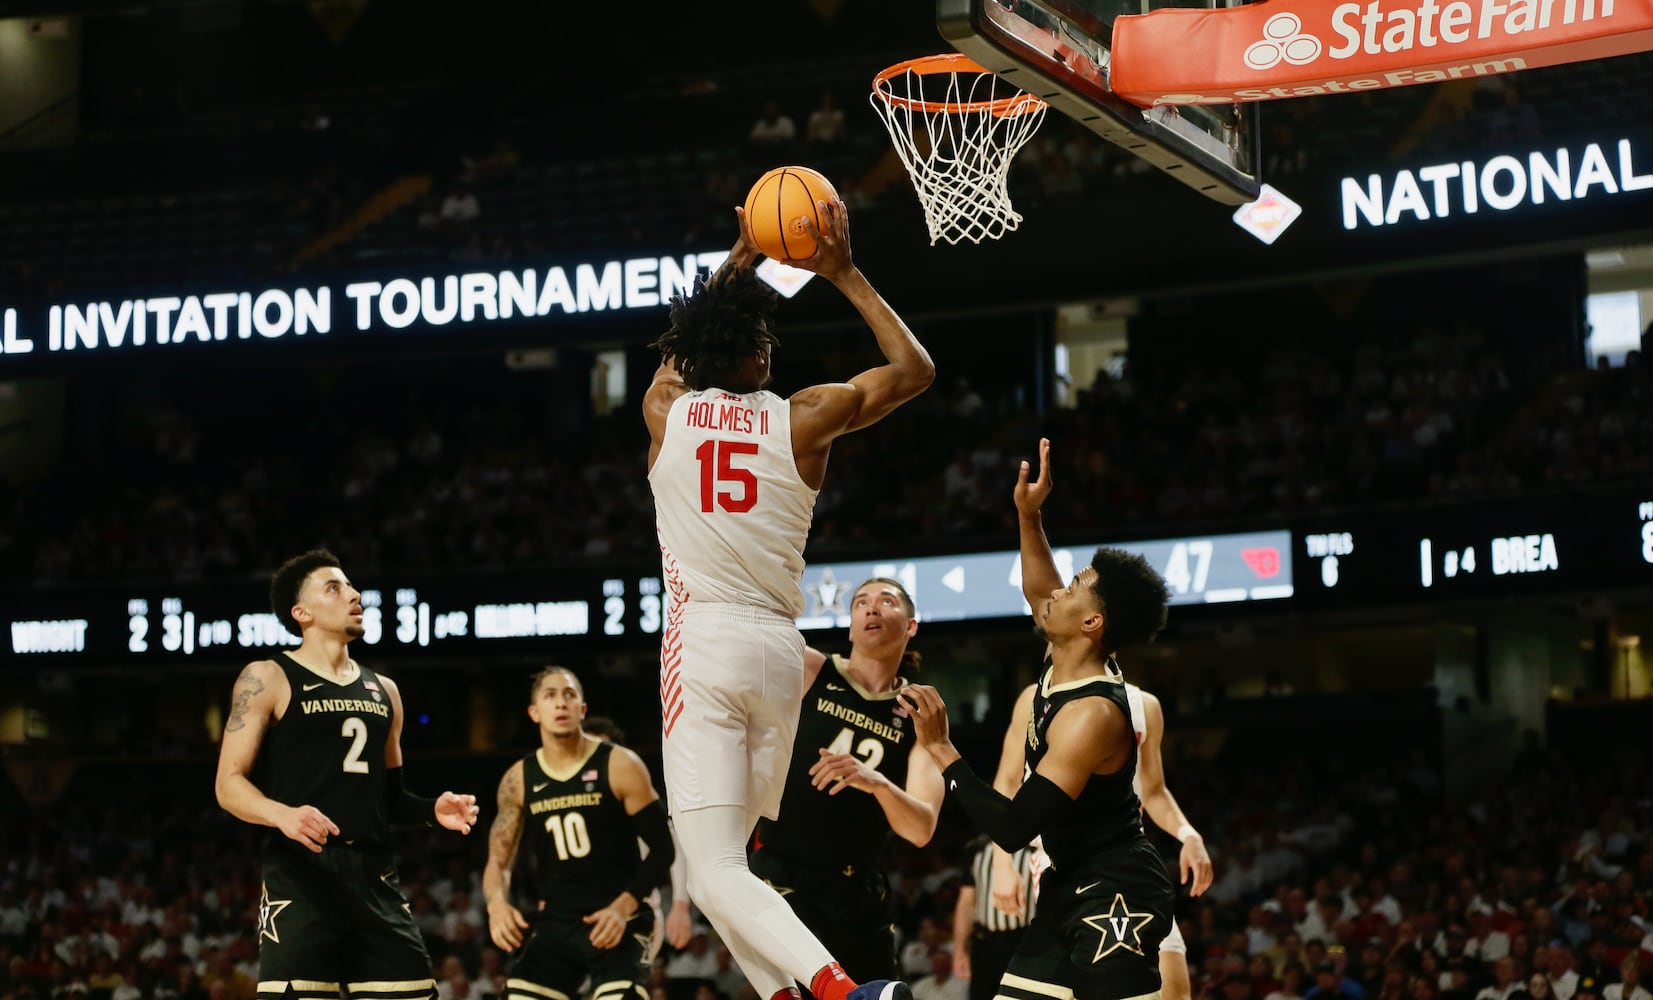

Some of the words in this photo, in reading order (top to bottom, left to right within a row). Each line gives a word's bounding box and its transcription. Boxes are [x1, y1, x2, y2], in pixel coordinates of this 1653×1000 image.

[1329, 0, 1472, 60] State
[1233, 78, 1379, 101] State
[1384, 57, 1528, 86] Farm
[1341, 138, 1653, 229] NATIONAL
[0, 307, 33, 354] L
[50, 286, 331, 351] INVITATION
[687, 401, 754, 434] HOLMES
[760, 410, 768, 435] II
[696, 440, 759, 513] 15
[1163, 541, 1213, 594] 47
[1491, 533, 1559, 576] BREA
[128, 614, 148, 652] 2
[162, 613, 182, 651] 3
[396, 605, 417, 643] 3
[604, 597, 625, 635] 2
[639, 594, 661, 633] 3
[301, 699, 389, 718] VANDERBILT
[817, 698, 904, 744] VANDERBILT
[341, 717, 370, 774] 2
[529, 792, 603, 815] VANDERBILT
[545, 812, 592, 861] 10
[1109, 917, 1130, 942] V
